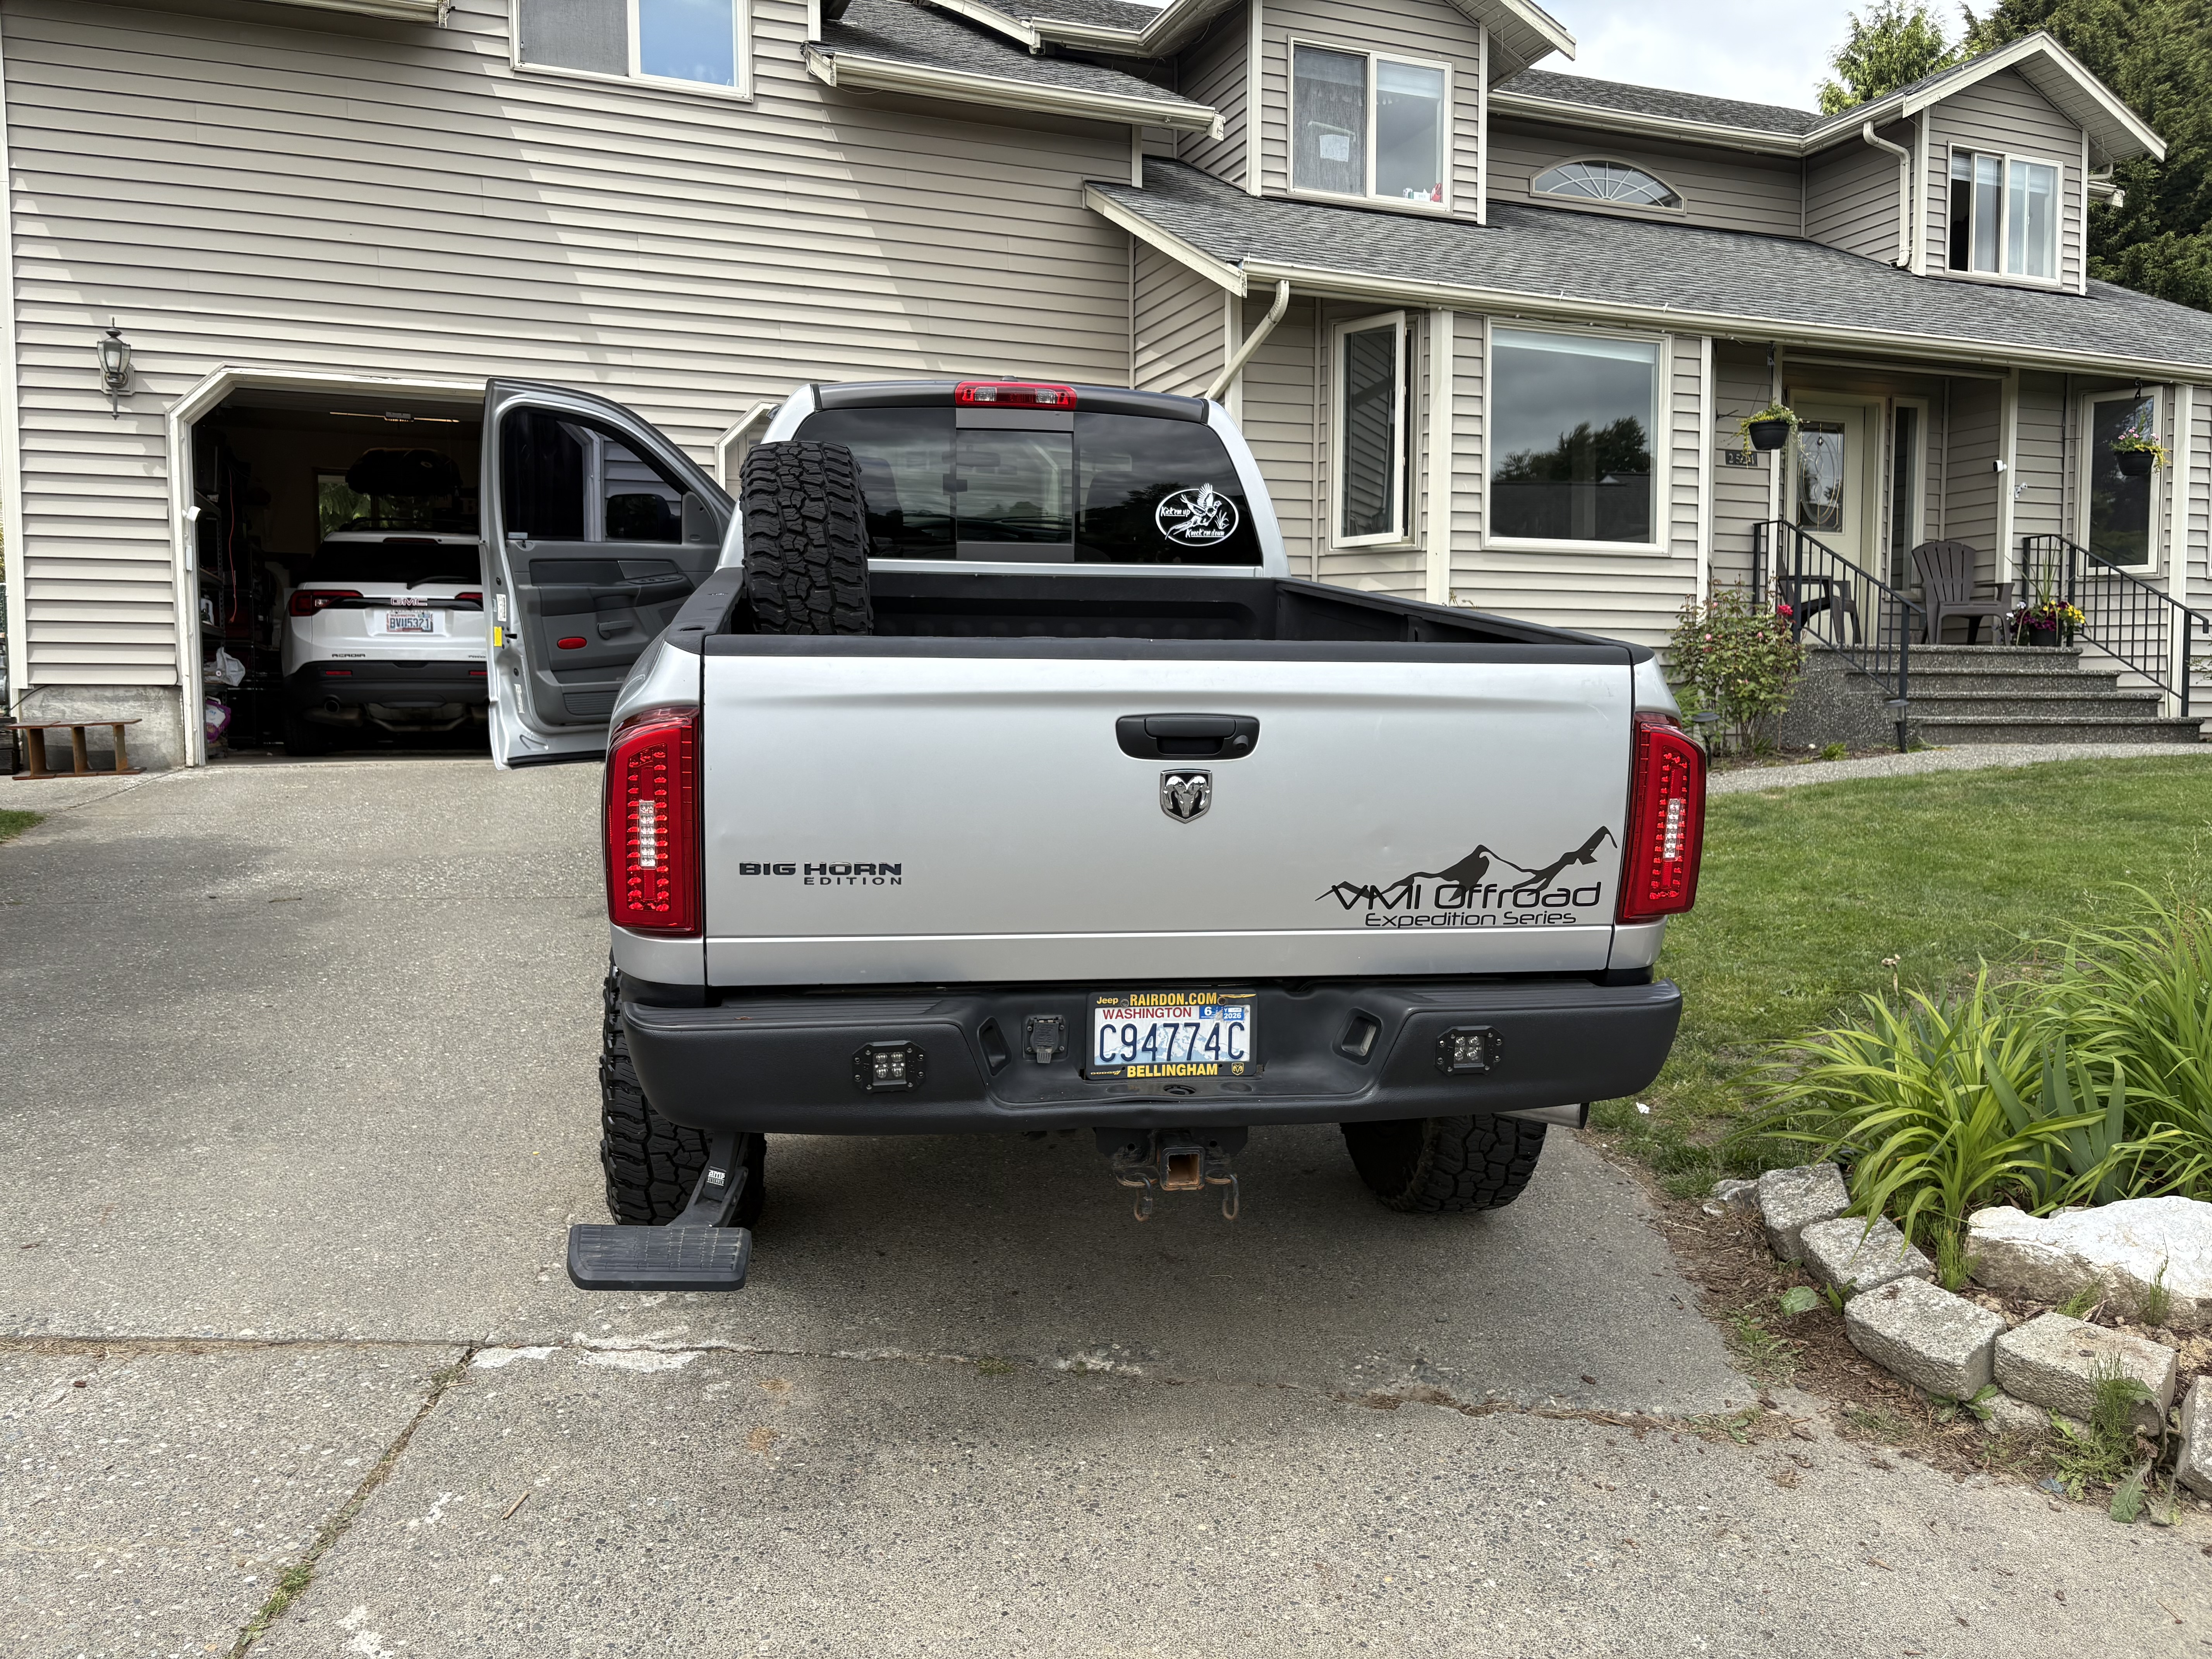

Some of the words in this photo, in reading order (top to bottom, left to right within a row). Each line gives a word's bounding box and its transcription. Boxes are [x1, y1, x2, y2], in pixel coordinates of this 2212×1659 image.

[1183, 509, 1191, 517] up
[391, 598, 428, 606] GMC
[390, 618, 429, 629] BVU5321
[739, 861, 796, 876] BIG
[804, 861, 902, 876] HORN
[804, 877, 902, 885] EDITION
[1331, 884, 1422, 910] VMI
[1434, 882, 1601, 909] Offroad
[1365, 911, 1496, 928] Expedition
[1503, 910, 1577, 925] Series
[1096, 996, 1119, 1005] Jeep
[1130, 993, 1217, 1006] RAIRDON.COM
[1103, 1007, 1192, 1019] WASHINGTON
[1204, 1006, 1212, 1016] 6
[1099, 1022, 1245, 1063] C94774C
[1127, 1063, 1218, 1078] BELLINGHAM
